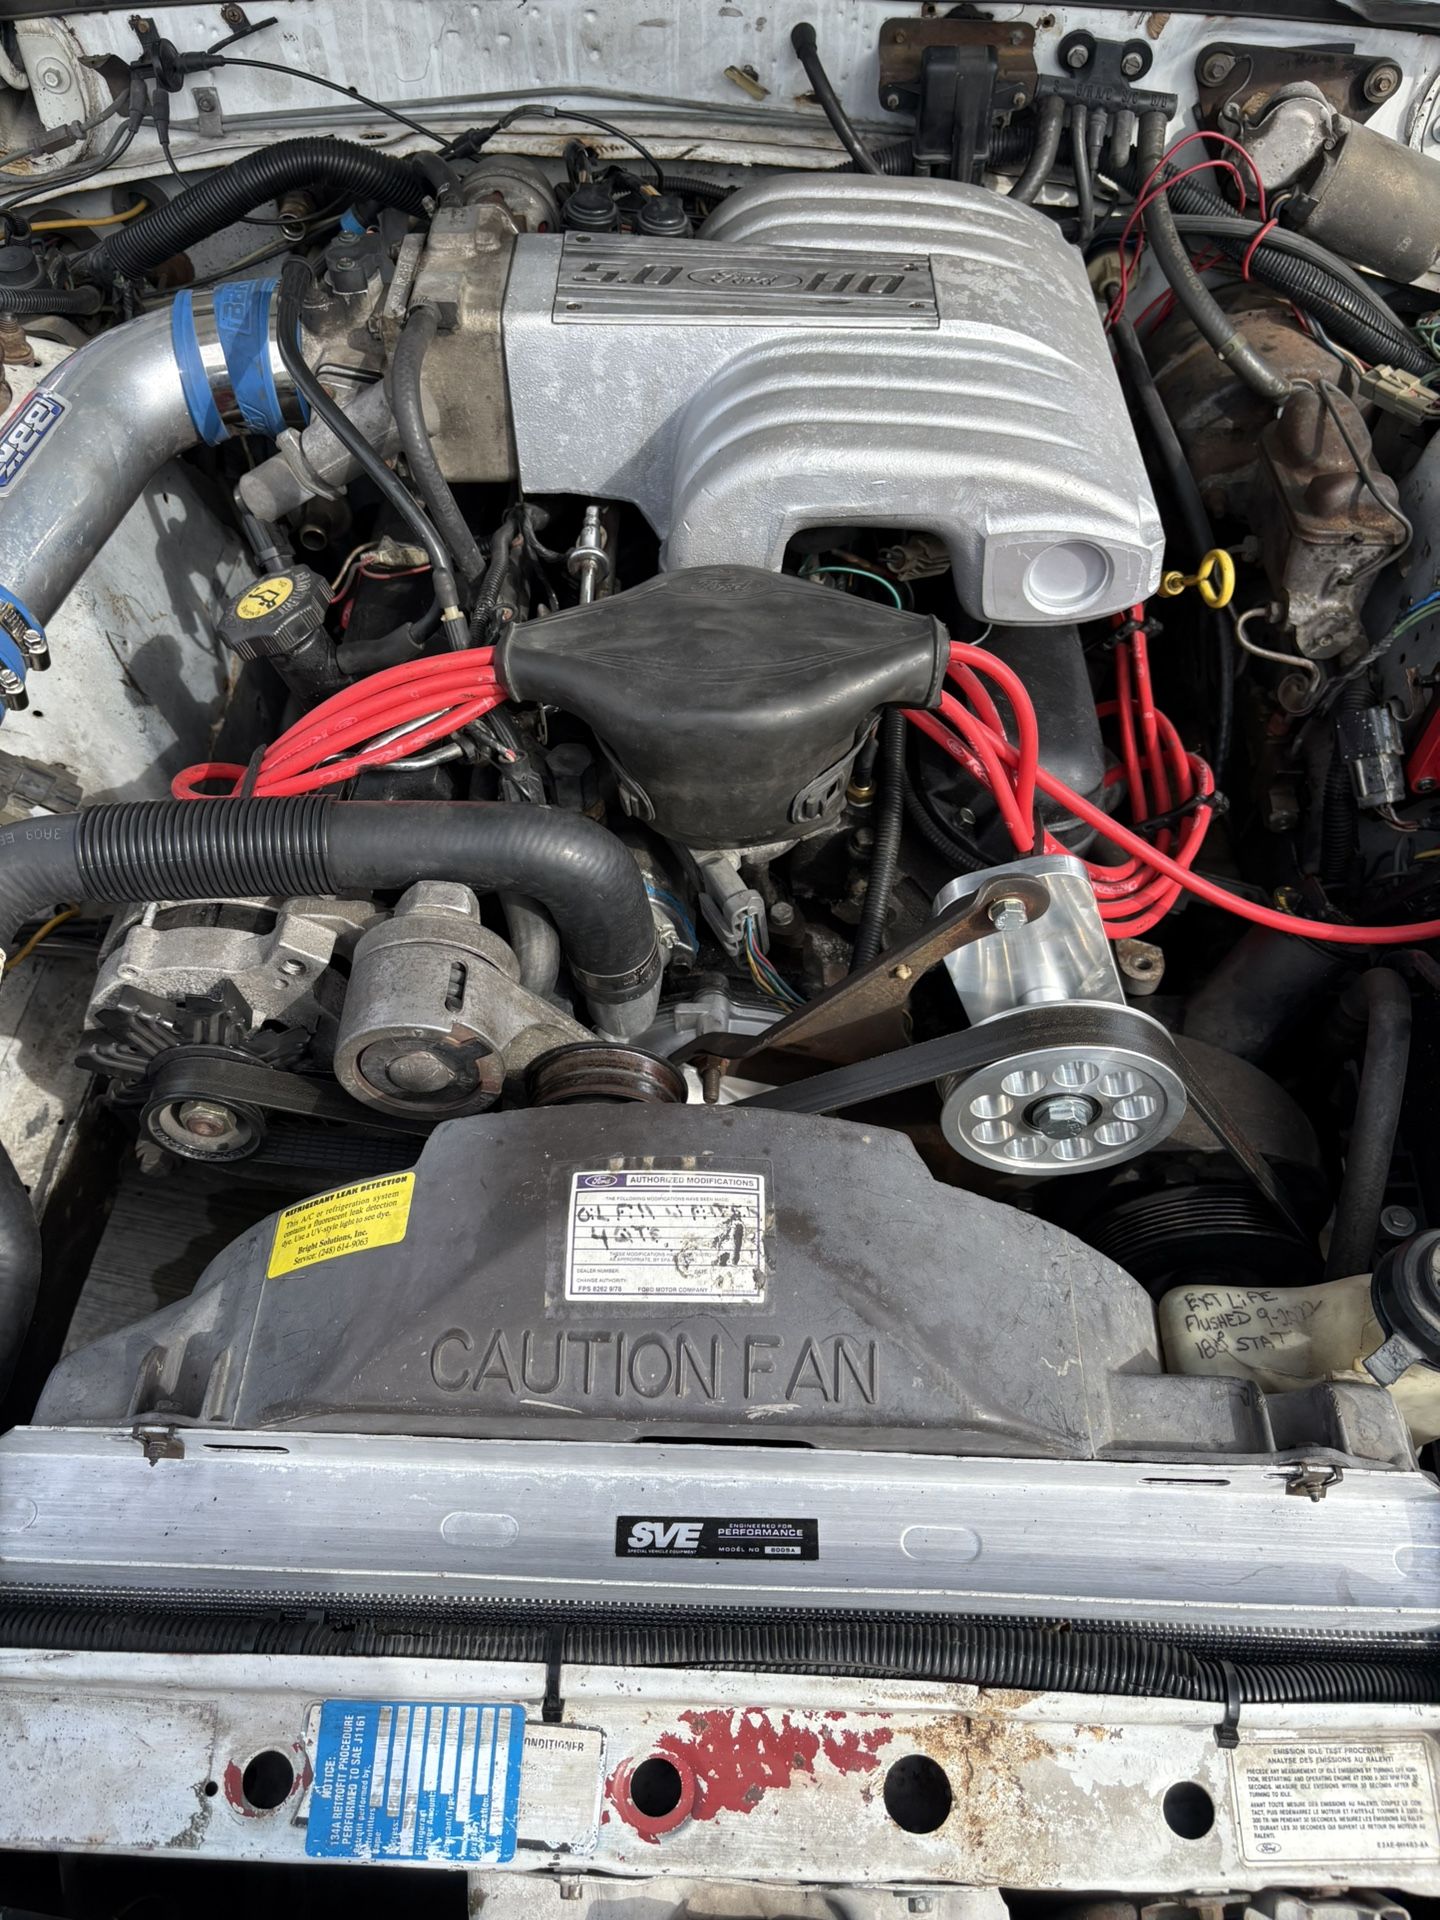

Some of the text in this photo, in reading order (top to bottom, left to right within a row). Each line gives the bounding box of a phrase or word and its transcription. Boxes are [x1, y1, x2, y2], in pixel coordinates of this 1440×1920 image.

[572, 262, 905, 294] 5.0 Ford HO
[592, 1176, 754, 1186] Ford AUTHORIZED MODIFICATIONS
[285, 1176, 408, 1218] REFRIGERANT LEAK DETECTION
[286, 1218, 298, 1229] This
[326, 1198, 369, 1215] refrigeration
[373, 1191, 399, 1202] system
[366, 1200, 397, 1211] detection
[311, 1222, 338, 1236] UV-style
[376, 1210, 391, 1219] dye.
[293, 1237, 368, 1265] Service: (248) 614-9063
[298, 1242, 318, 1254] Bright
[319, 1234, 352, 1247] Solutions,
[1236, 1330, 1291, 1352] STAT
[430, 1326, 881, 1404] CAUTION FAN
[628, 1521, 704, 1548] SVE
[718, 1528, 803, 1536] PERFORMANCE
[524, 1737, 584, 1751] ONDITIONER
[321, 1757, 336, 1798] NOTICE:
[331, 1715, 354, 1845] 134A RETROFIT PROCEDURE
[342, 1715, 366, 1844] PERFORMED TO SAE J1161
[358, 1780, 368, 1820] performed
